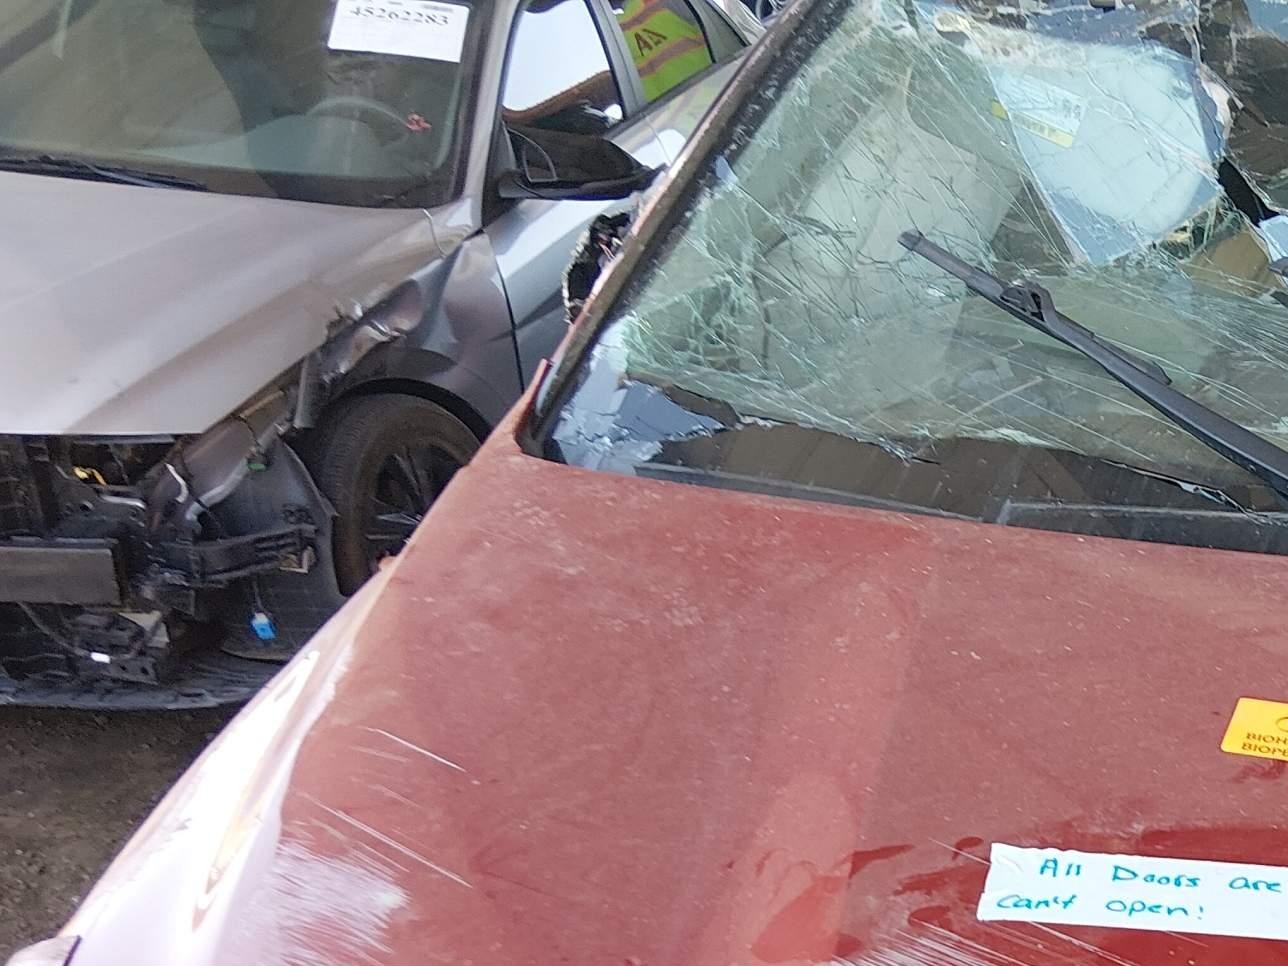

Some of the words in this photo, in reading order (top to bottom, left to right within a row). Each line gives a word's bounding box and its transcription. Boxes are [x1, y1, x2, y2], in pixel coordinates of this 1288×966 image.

[1039, 857, 1084, 878] All
[1111, 864, 1201, 889] Doors
[1229, 876, 1282, 893] are
